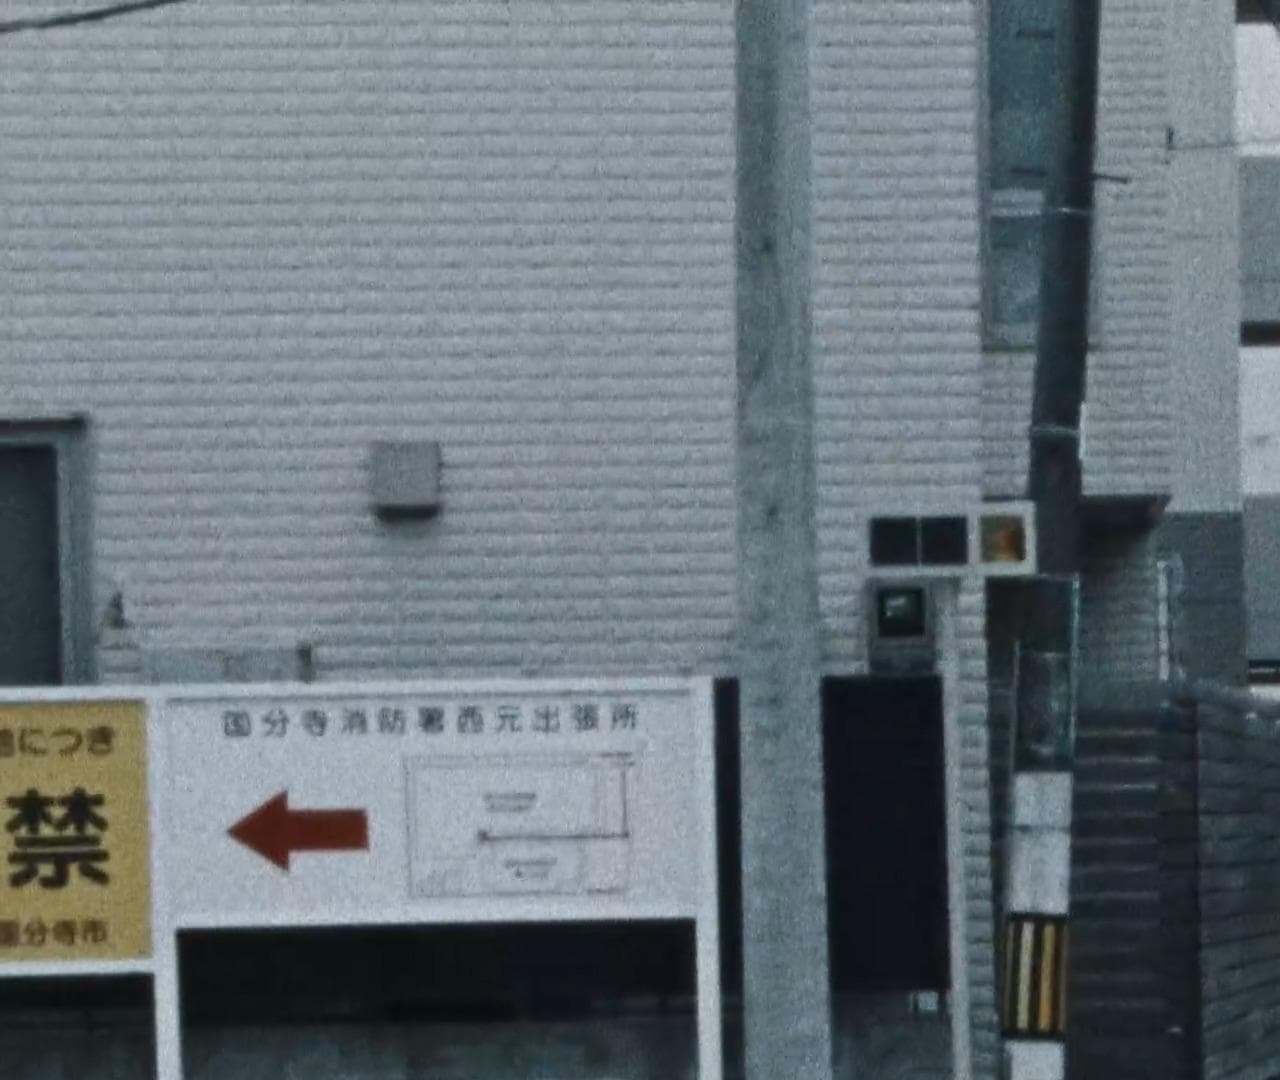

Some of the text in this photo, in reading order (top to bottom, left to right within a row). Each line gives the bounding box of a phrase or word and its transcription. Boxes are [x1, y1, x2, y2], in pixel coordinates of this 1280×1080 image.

[222, 703, 638, 736] 国分寺消防署西元出張所
[5, 787, 110, 888] 禁
